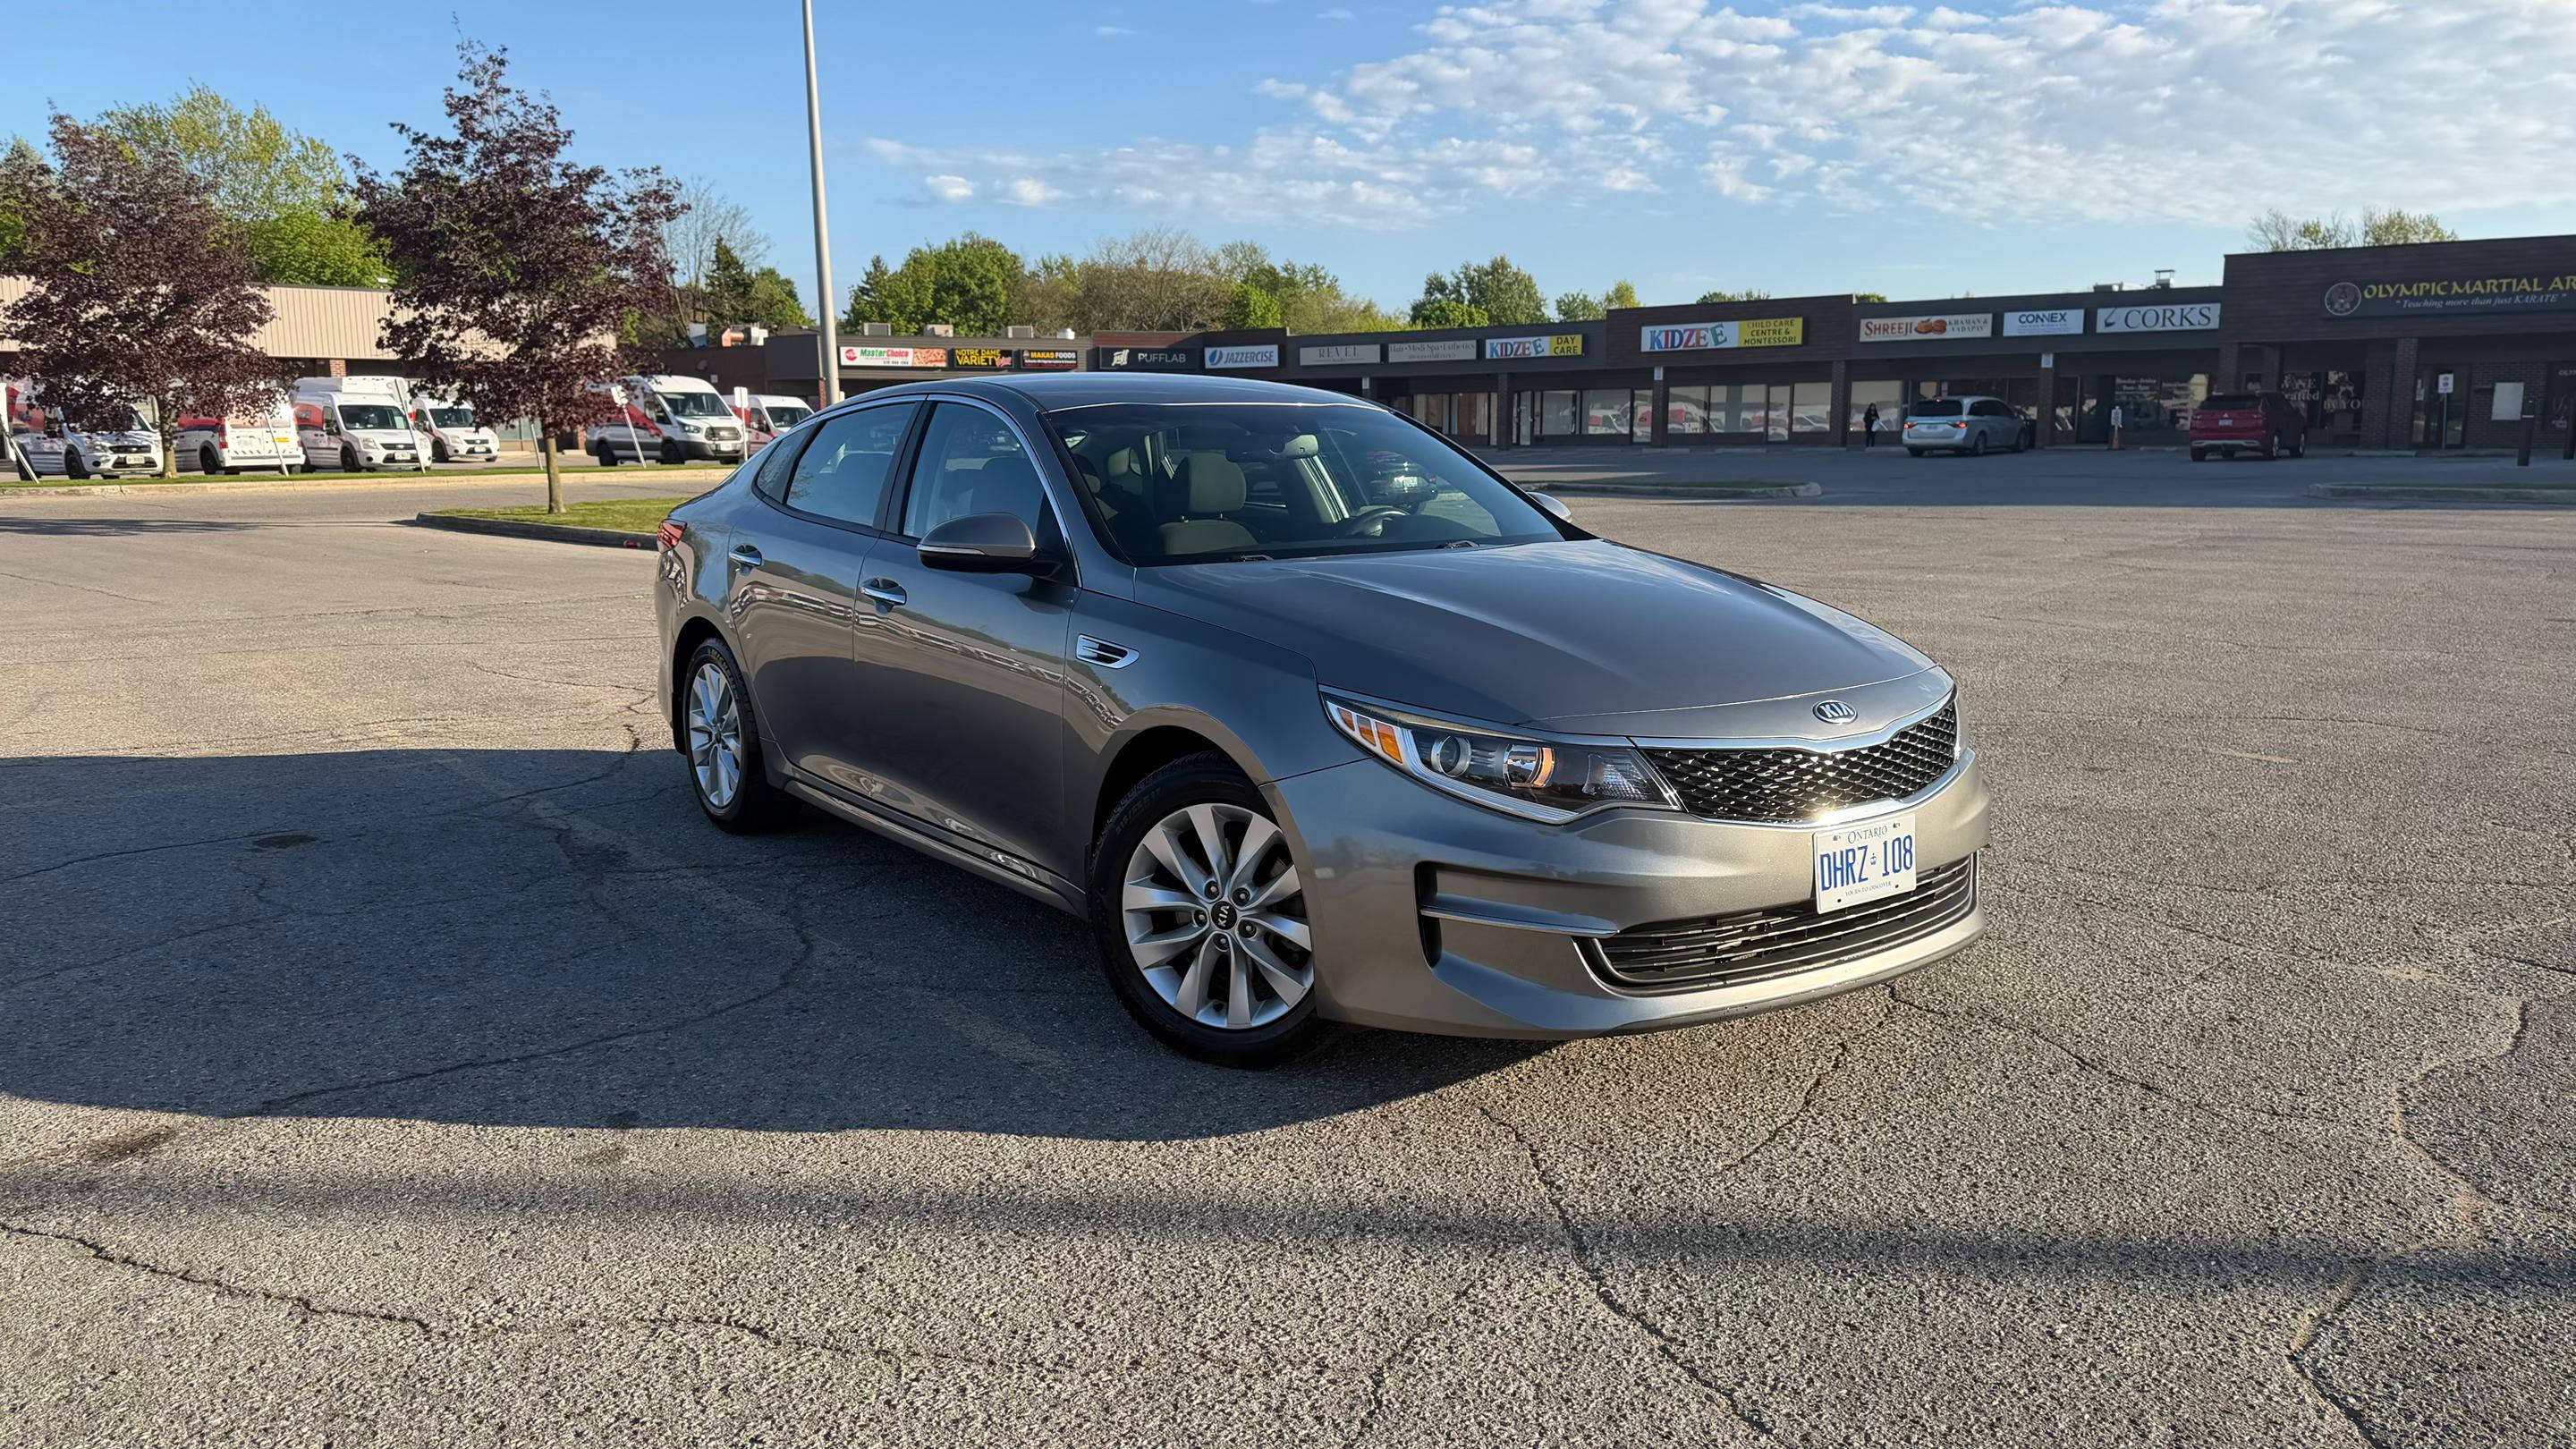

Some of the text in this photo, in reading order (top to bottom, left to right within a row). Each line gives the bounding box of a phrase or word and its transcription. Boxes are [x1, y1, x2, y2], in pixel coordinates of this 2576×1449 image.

[2363, 281, 2448, 299] OLYMPIC
[2451, 277, 2542, 294] MARTIAL
[2402, 299, 2444, 309] Teaching
[2471, 297, 2491, 305] than
[2492, 296, 2512, 306] just
[2513, 293, 2558, 303] KARATE
[1747, 318, 1795, 329] CHILD CARE
[2018, 312, 2068, 325] CONNEX
[2124, 306, 2212, 329] CORKS
[1750, 328, 1783, 337] CENTRE
[1864, 321, 1913, 336] SHREEJI
[1556, 335, 1576, 345] DAY
[1649, 322, 1728, 351] KIDZEE
[1744, 336, 1797, 345] MONTESSORI
[1489, 338, 1545, 358] KIDZEE
[1553, 345, 1579, 355] CARE
[956, 355, 1001, 366] VARIETY
[1138, 353, 1186, 363] PUFFLAB
[1224, 351, 1275, 364] JAZZERCISE
[1819, 705, 1854, 718] KIA
[1819, 834, 1913, 892] DHRZ 108
[1217, 905, 1230, 928] KIA
